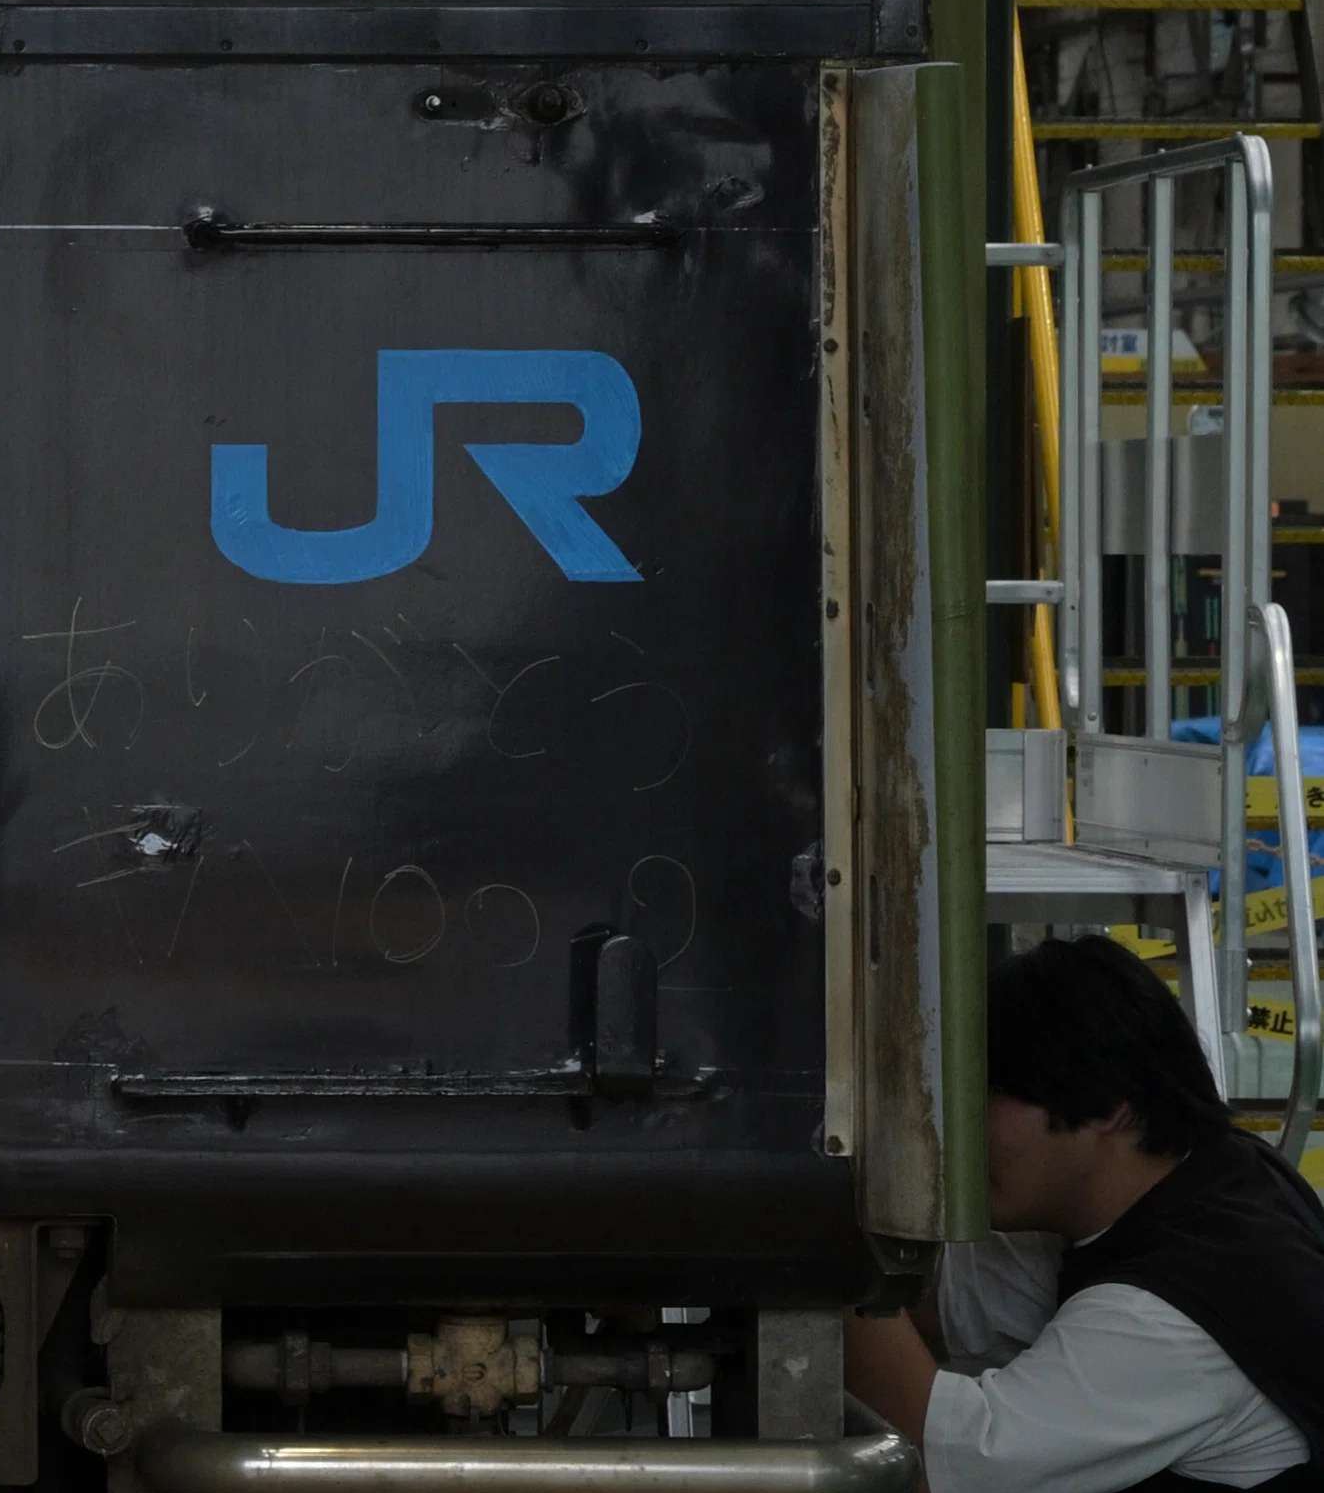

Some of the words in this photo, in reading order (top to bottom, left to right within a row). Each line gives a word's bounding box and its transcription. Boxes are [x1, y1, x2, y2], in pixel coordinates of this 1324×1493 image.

[210, 349, 645, 585] JR
[22, 597, 691, 791] ありがとう
